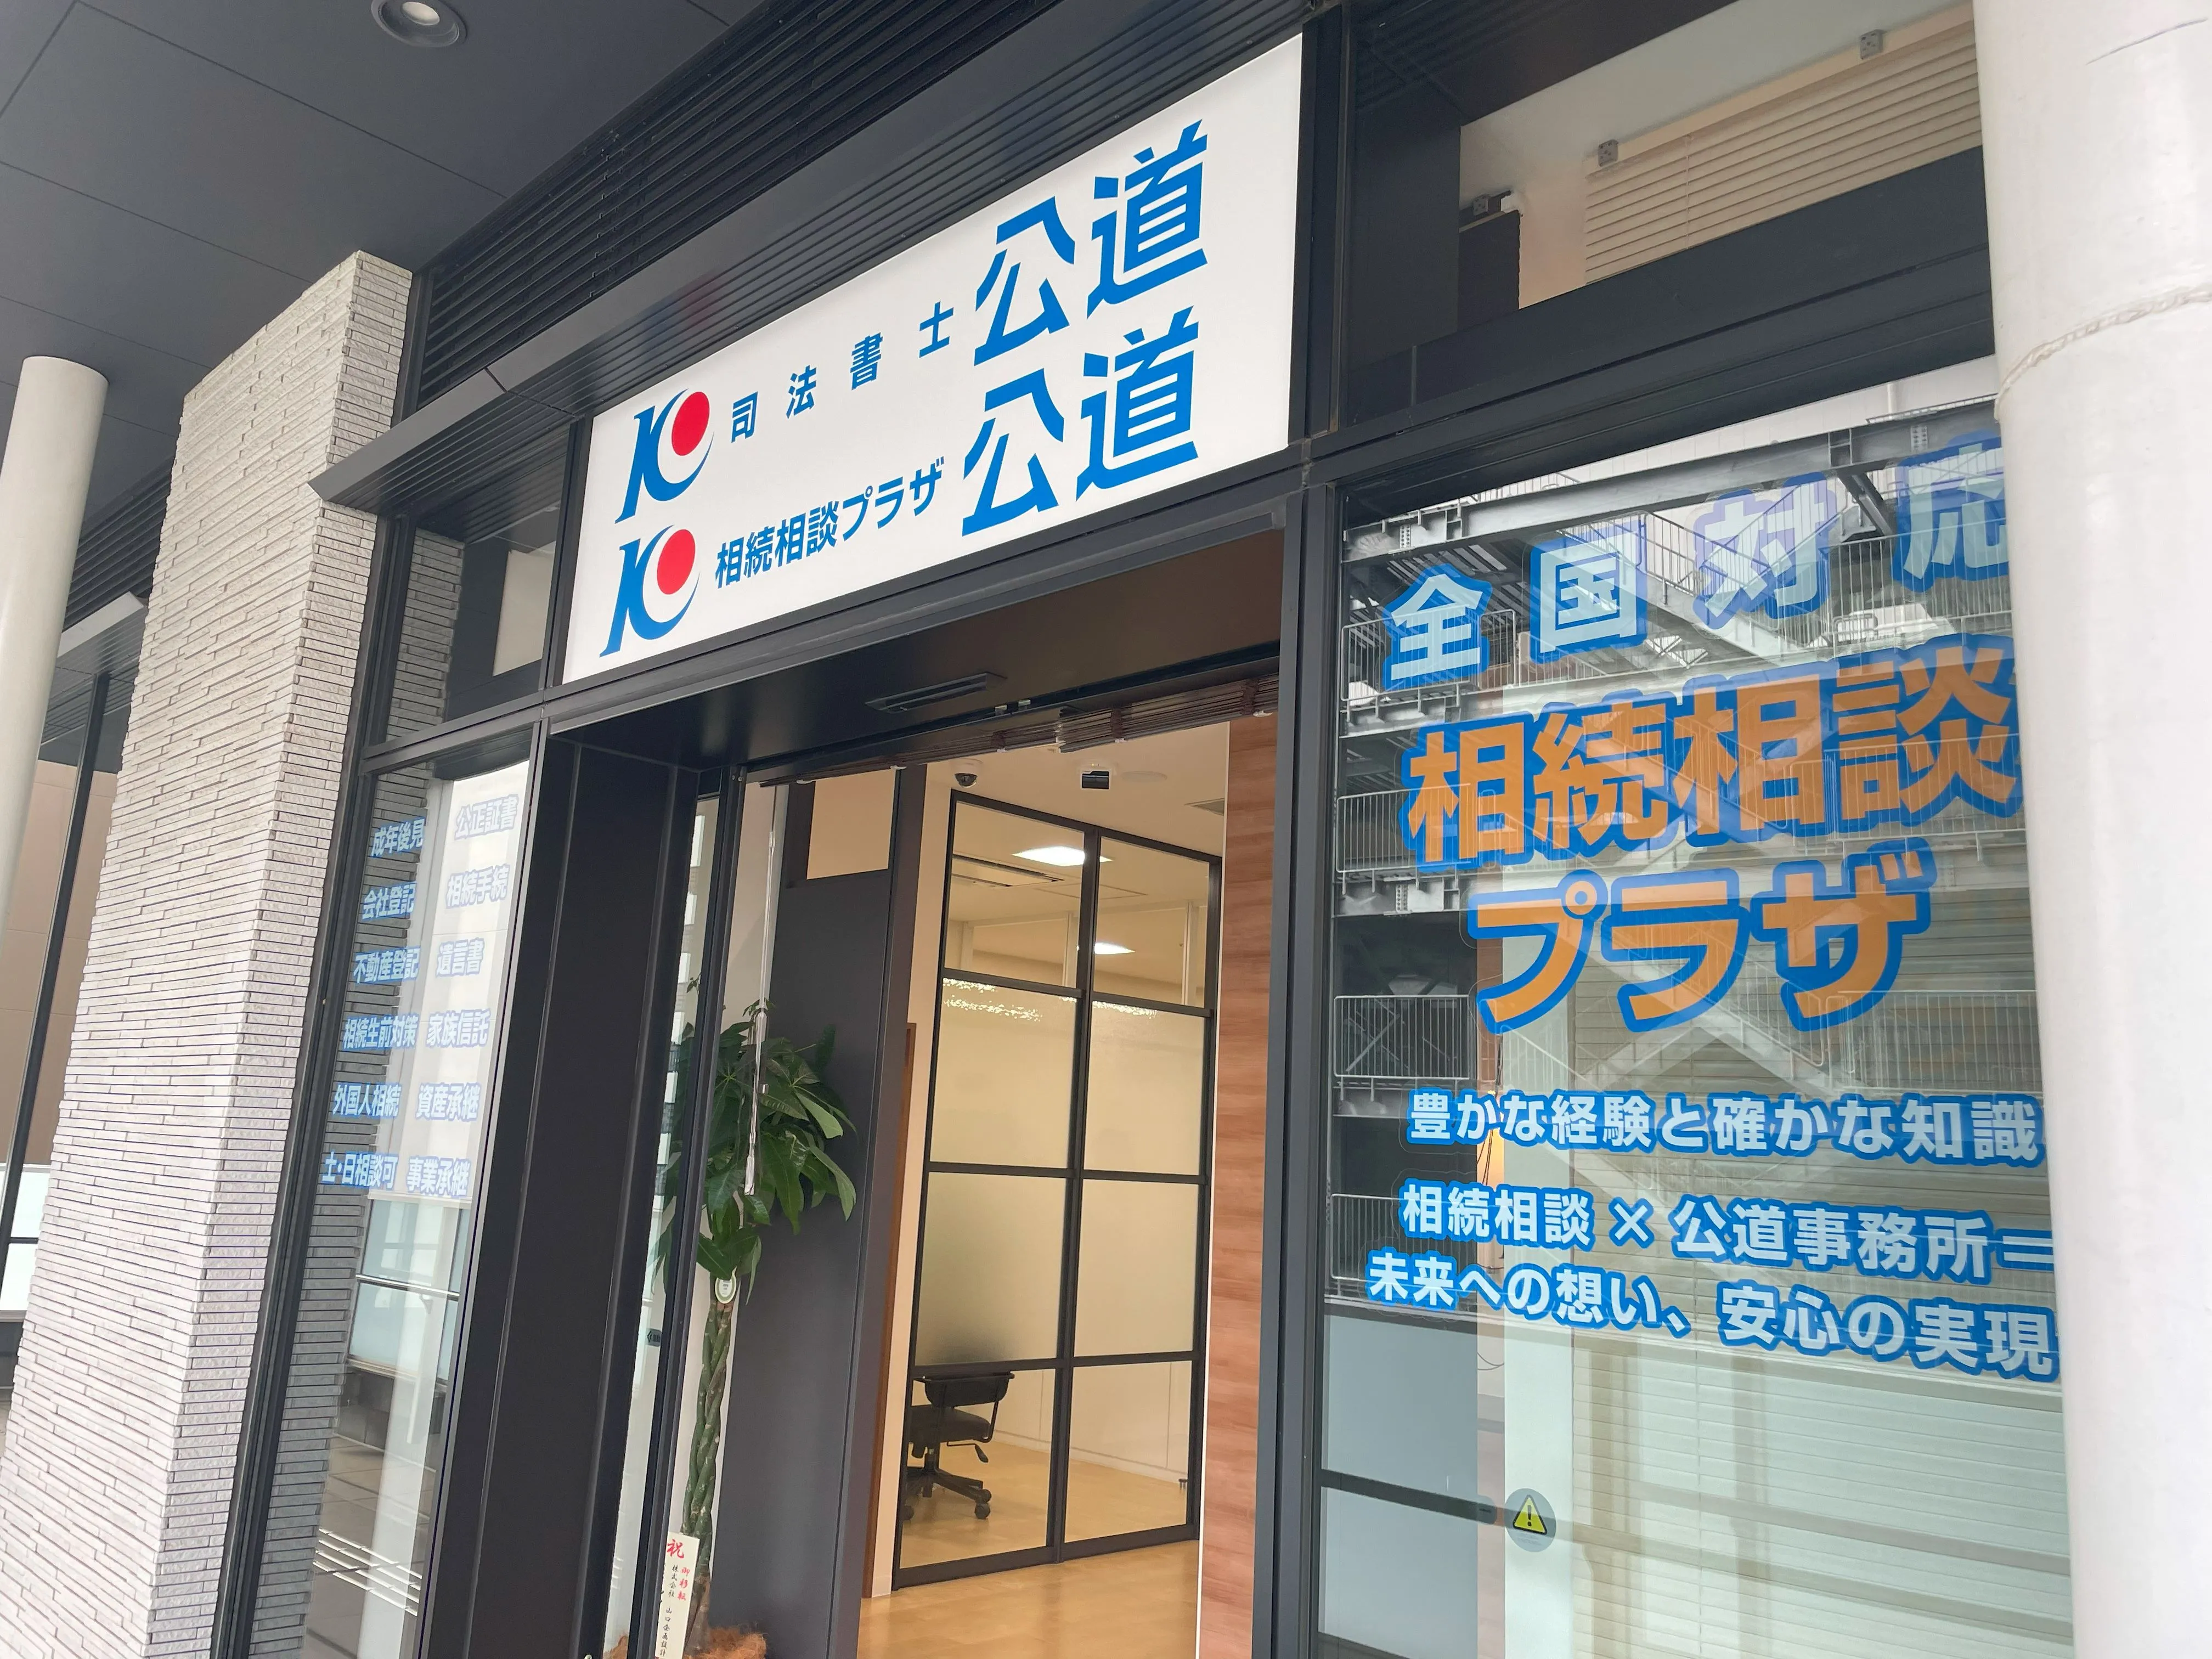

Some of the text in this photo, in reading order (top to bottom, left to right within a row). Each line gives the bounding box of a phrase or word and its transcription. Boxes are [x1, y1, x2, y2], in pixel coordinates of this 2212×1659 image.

[731, 119, 1208, 443] 司法書士 公道
[715, 305, 1199, 589] 相続相談プラザ 公道
[1409, 647, 2017, 862] 相続相談
[455, 796, 518, 838] 公正証書
[371, 818, 425, 856] 成年後見
[362, 883, 416, 919] 会社登記
[446, 865, 510, 907] 相続手続
[1477, 850, 1923, 1023] プラザ
[353, 948, 420, 984] 不動産登記
[436, 939, 484, 977] 遺言書
[342, 1014, 419, 1049] 相続生前対策
[426, 1009, 490, 1046] 家族信託
[332, 1084, 401, 1117] 外国人相続
[416, 1085, 481, 1120] 資産承継
[1410, 1093, 2039, 1160] 豊かな経験と確かな知識
[407, 1156, 471, 1197] 事業承継
[1403, 1183, 1591, 1246] 相続相談
[666, 1538, 684, 1559] 祝
